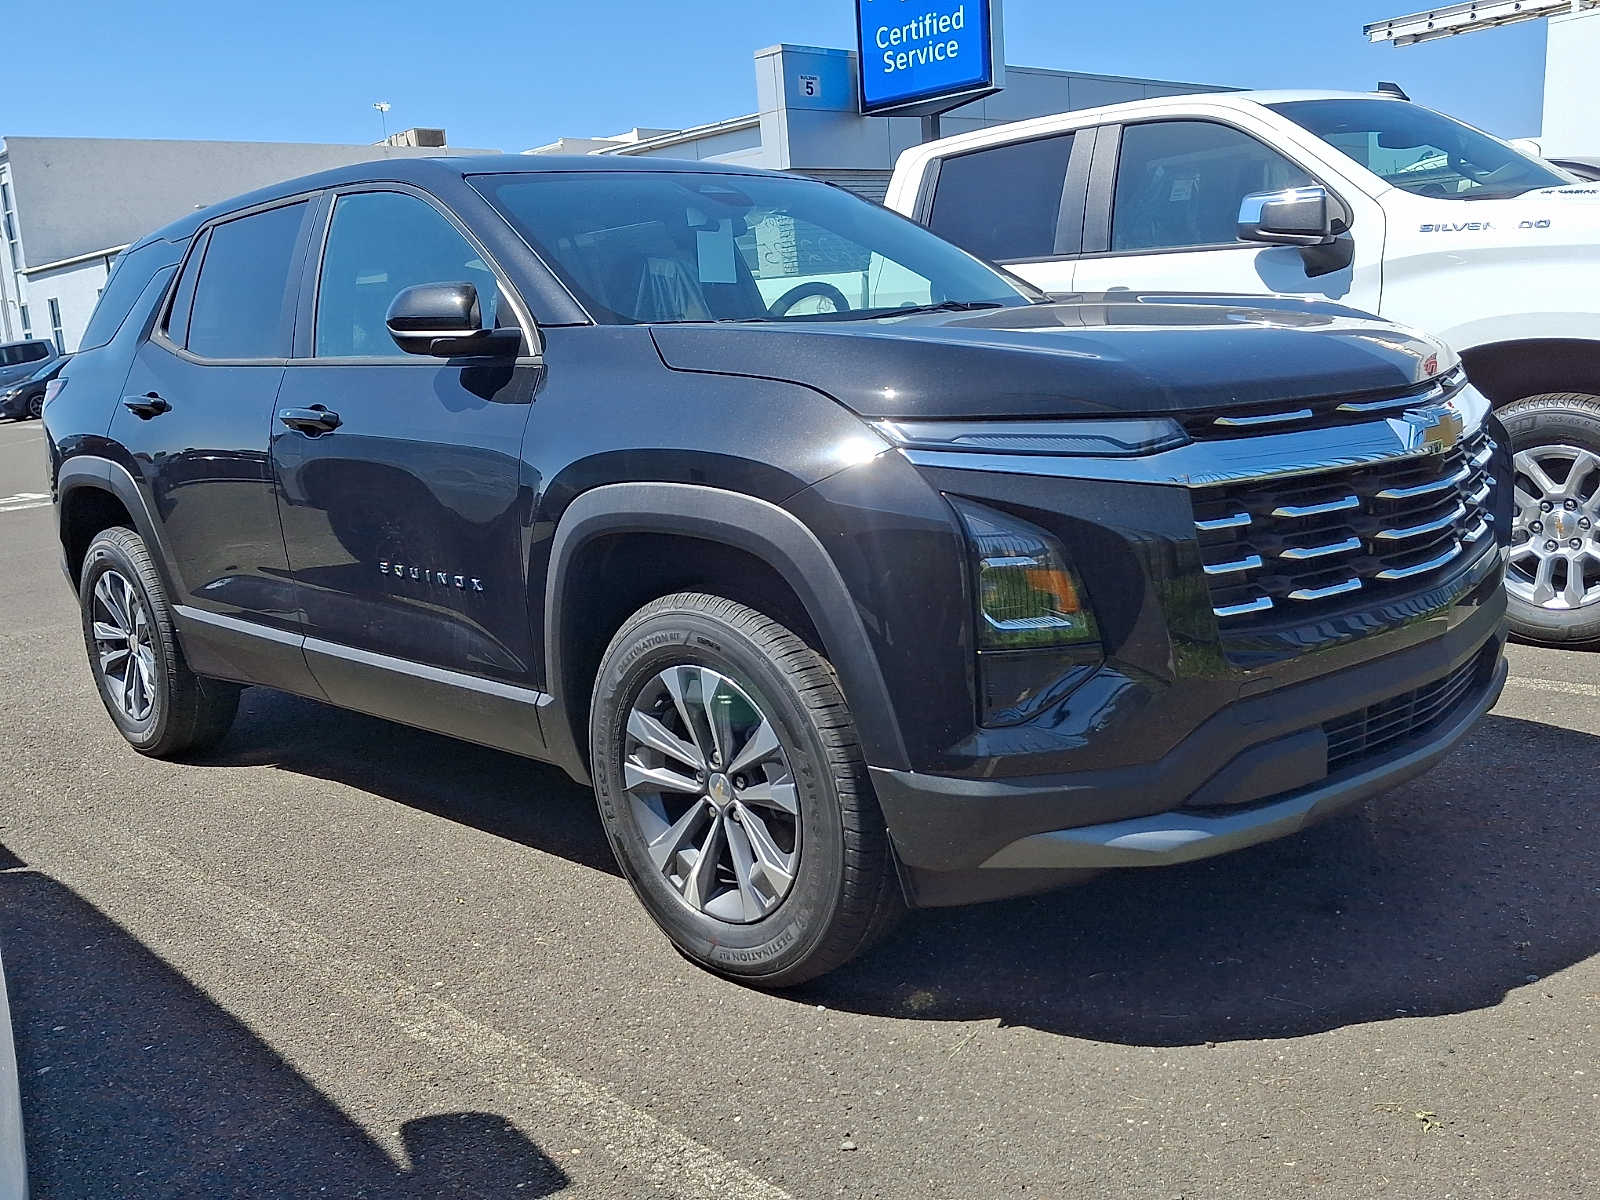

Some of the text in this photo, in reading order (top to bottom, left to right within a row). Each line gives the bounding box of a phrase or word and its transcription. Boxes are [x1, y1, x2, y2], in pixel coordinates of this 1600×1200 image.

[876, 4, 964, 49] Certified
[883, 40, 959, 73] Service
[805, 81, 814, 96] 5
[1419, 219, 1551, 233] SILVERDO
[380, 562, 483, 591] EQUINOX
[734, 932, 794, 962] DESTINATION
